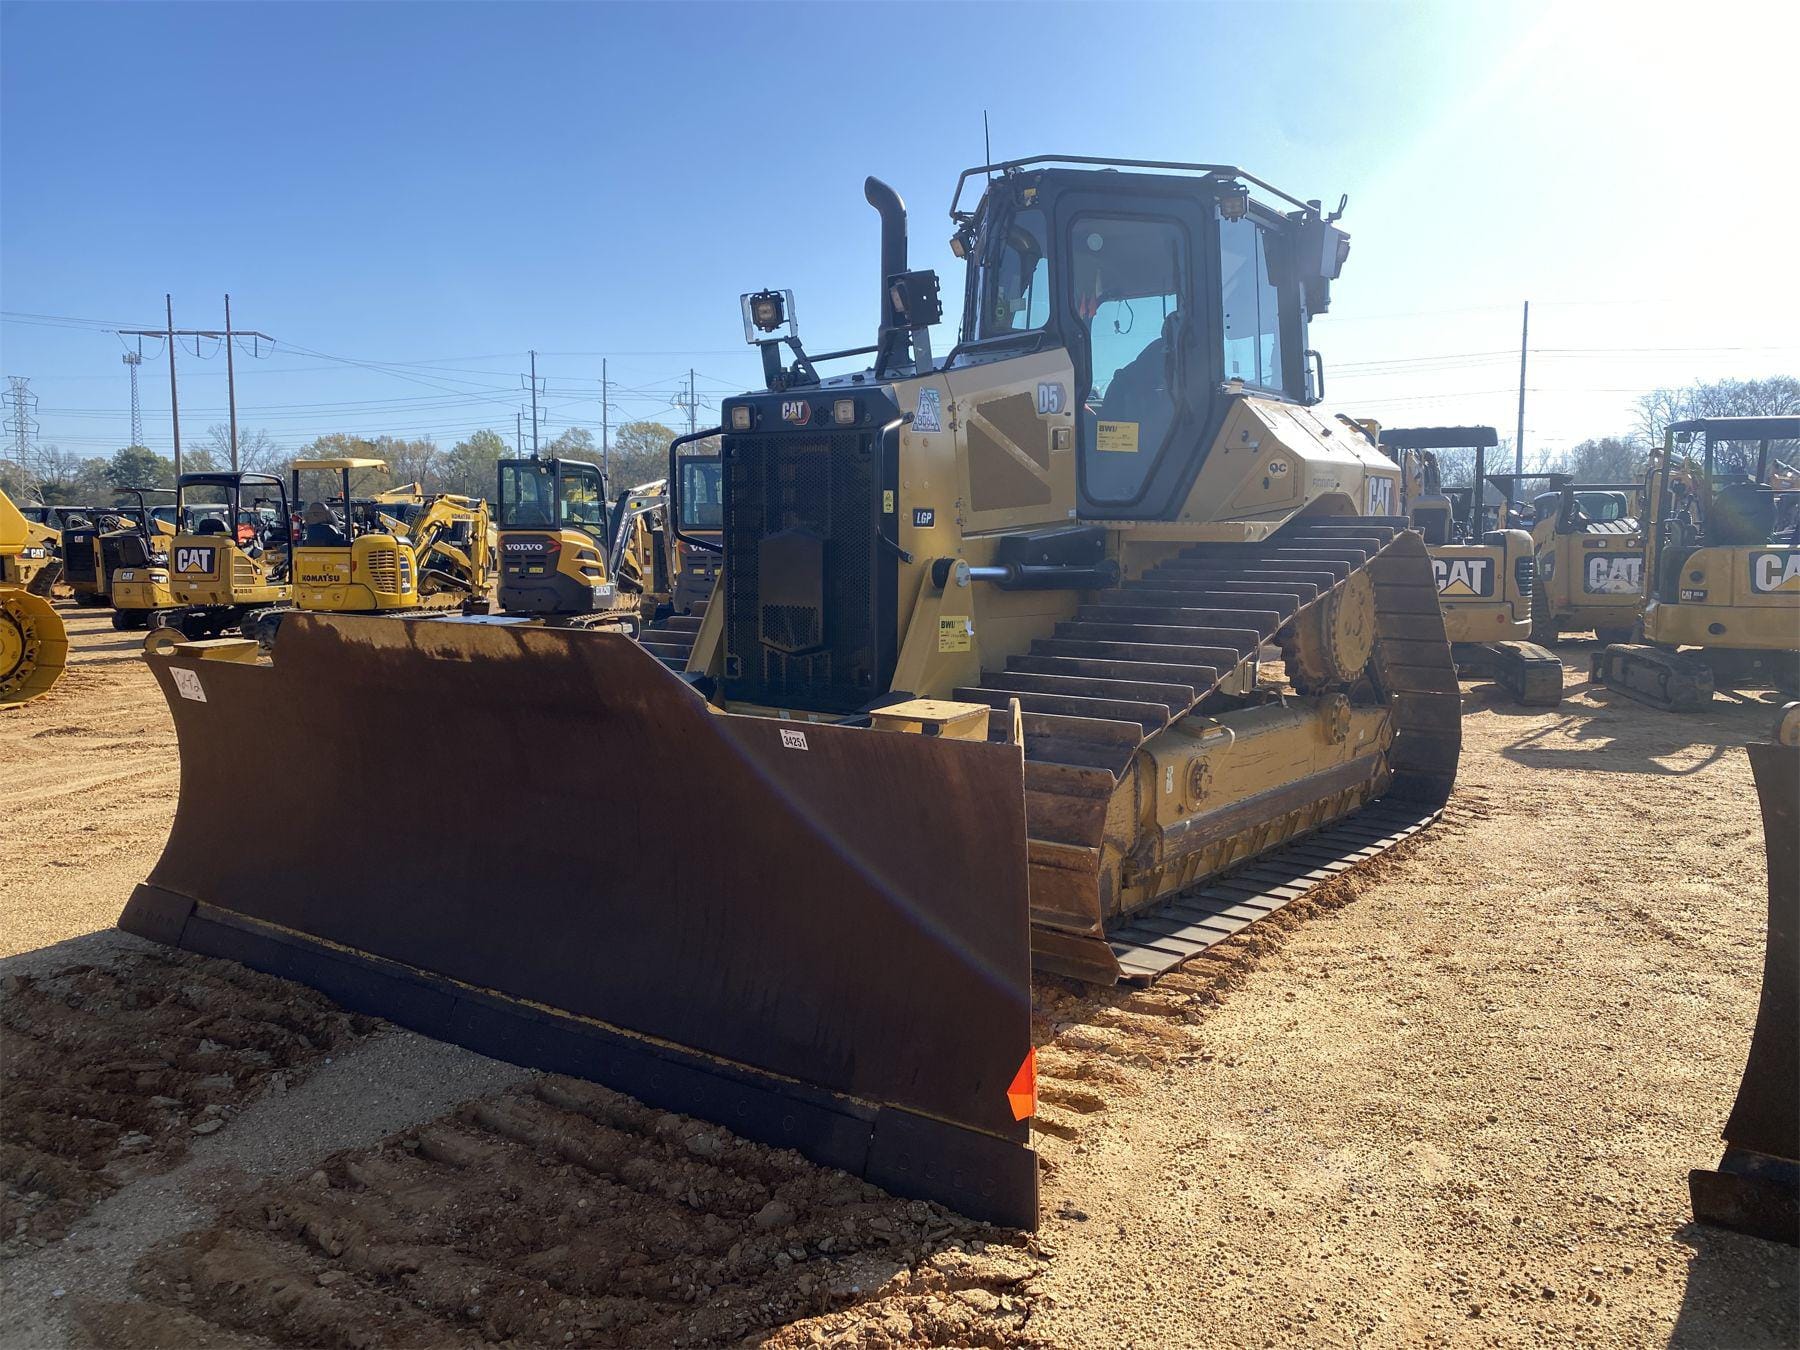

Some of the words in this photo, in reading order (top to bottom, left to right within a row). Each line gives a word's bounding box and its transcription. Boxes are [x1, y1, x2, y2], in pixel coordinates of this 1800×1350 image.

[1038, 385, 1058, 413] D5
[782, 401, 804, 420] CAT
[1269, 462, 1287, 474] QC
[1368, 477, 1392, 516] CAT
[916, 511, 932, 524] LGP
[31, 548, 44, 559] CAT
[506, 543, 543, 551] VOLVO
[177, 548, 211, 573] CAT
[122, 572, 134, 580] CAT
[302, 573, 340, 582] KOMATSU
[1432, 559, 1487, 595] CAT
[1589, 557, 1642, 595] CAT
[1756, 553, 1800, 592] CA
[1682, 590, 1692, 600] CAT
[784, 735, 806, 748] 34251
